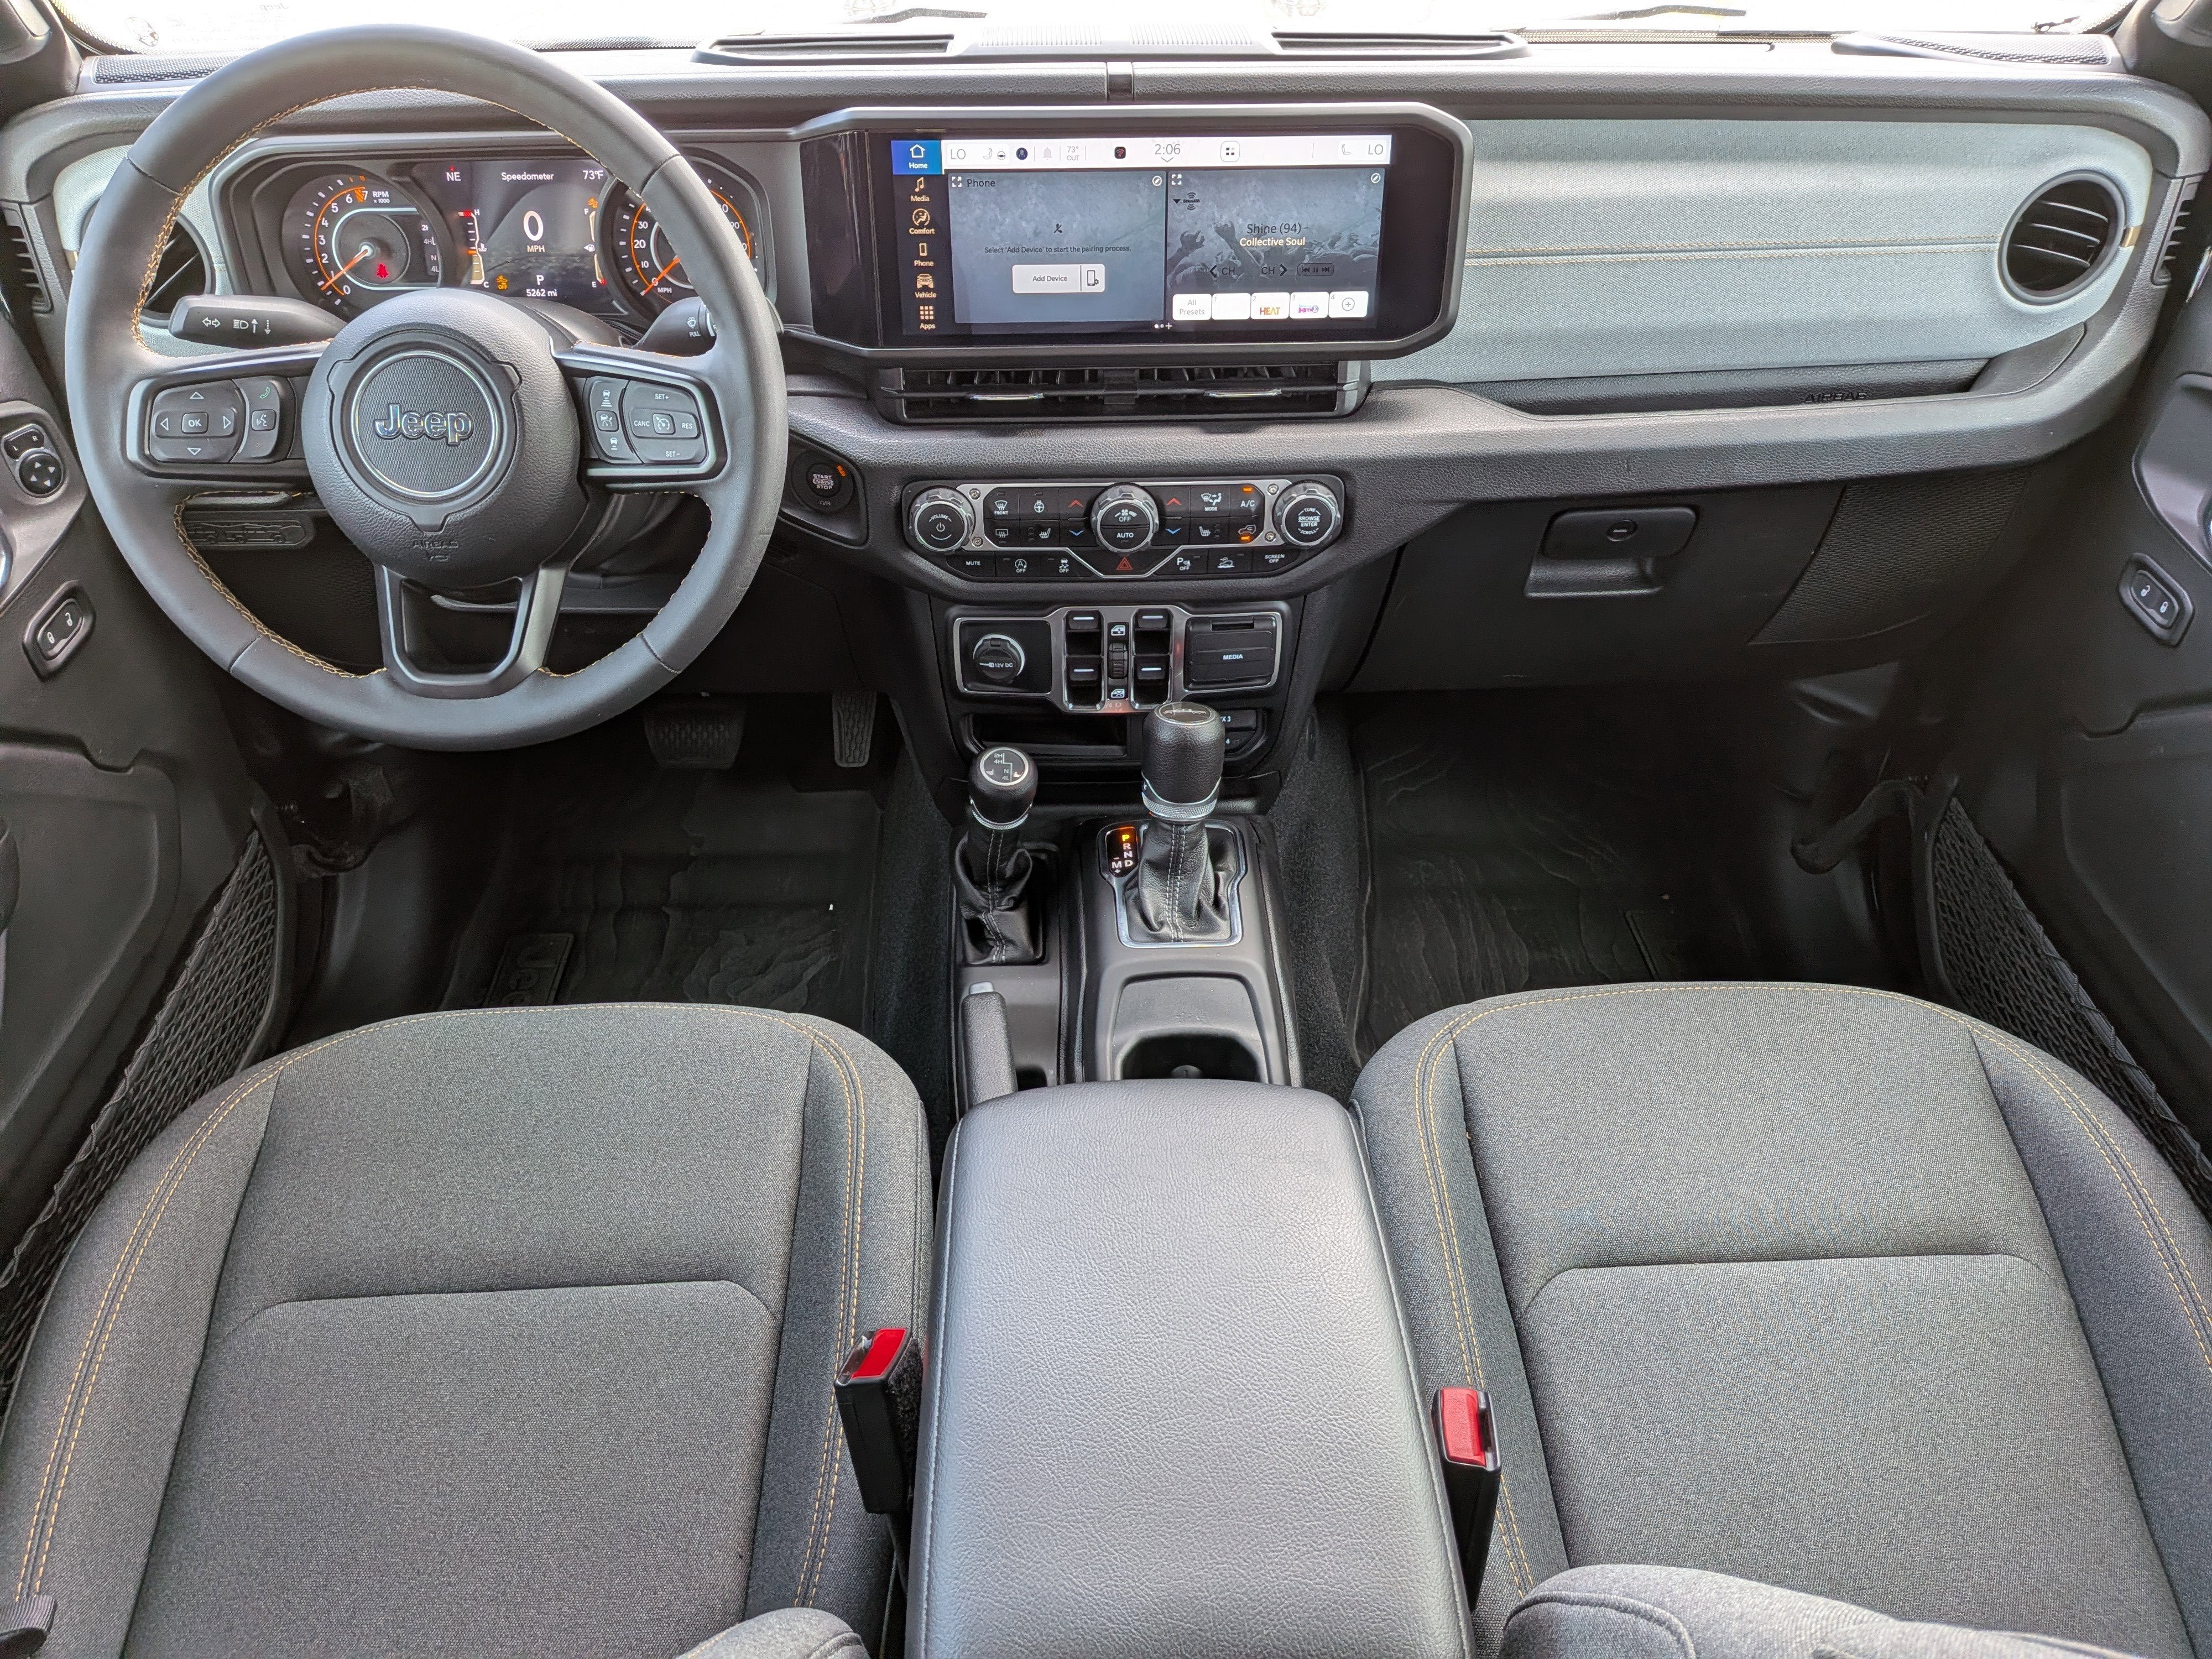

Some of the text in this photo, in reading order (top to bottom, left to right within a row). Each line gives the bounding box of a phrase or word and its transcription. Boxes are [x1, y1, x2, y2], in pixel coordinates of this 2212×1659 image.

[951, 149, 966, 160] LO
[1155, 144, 1181, 155] 2:06
[1368, 144, 1384, 155] LO
[447, 173, 461, 182] NE
[502, 172, 554, 181] Speedometer
[967, 179, 995, 187] Phone
[346, 194, 353, 204] 6
[362, 191, 368, 200] 7
[331, 203, 338, 213] 5
[322, 218, 328, 227] 4
[523, 211, 544, 241] 0
[1246, 223, 1302, 234] Shine (94)
[319, 236, 326, 245] 3
[634, 239, 646, 249] 20
[1240, 237, 1306, 247] Collective Soul
[527, 245, 545, 253] MPH
[321, 253, 328, 263] 2
[536, 275, 544, 285] P
[343, 285, 351, 295] 0
[526, 289, 557, 297] 5262 mi
[1260, 306, 1280, 315] HEAT
[188, 419, 201, 427] OK
[374, 404, 473, 446] Jeep
